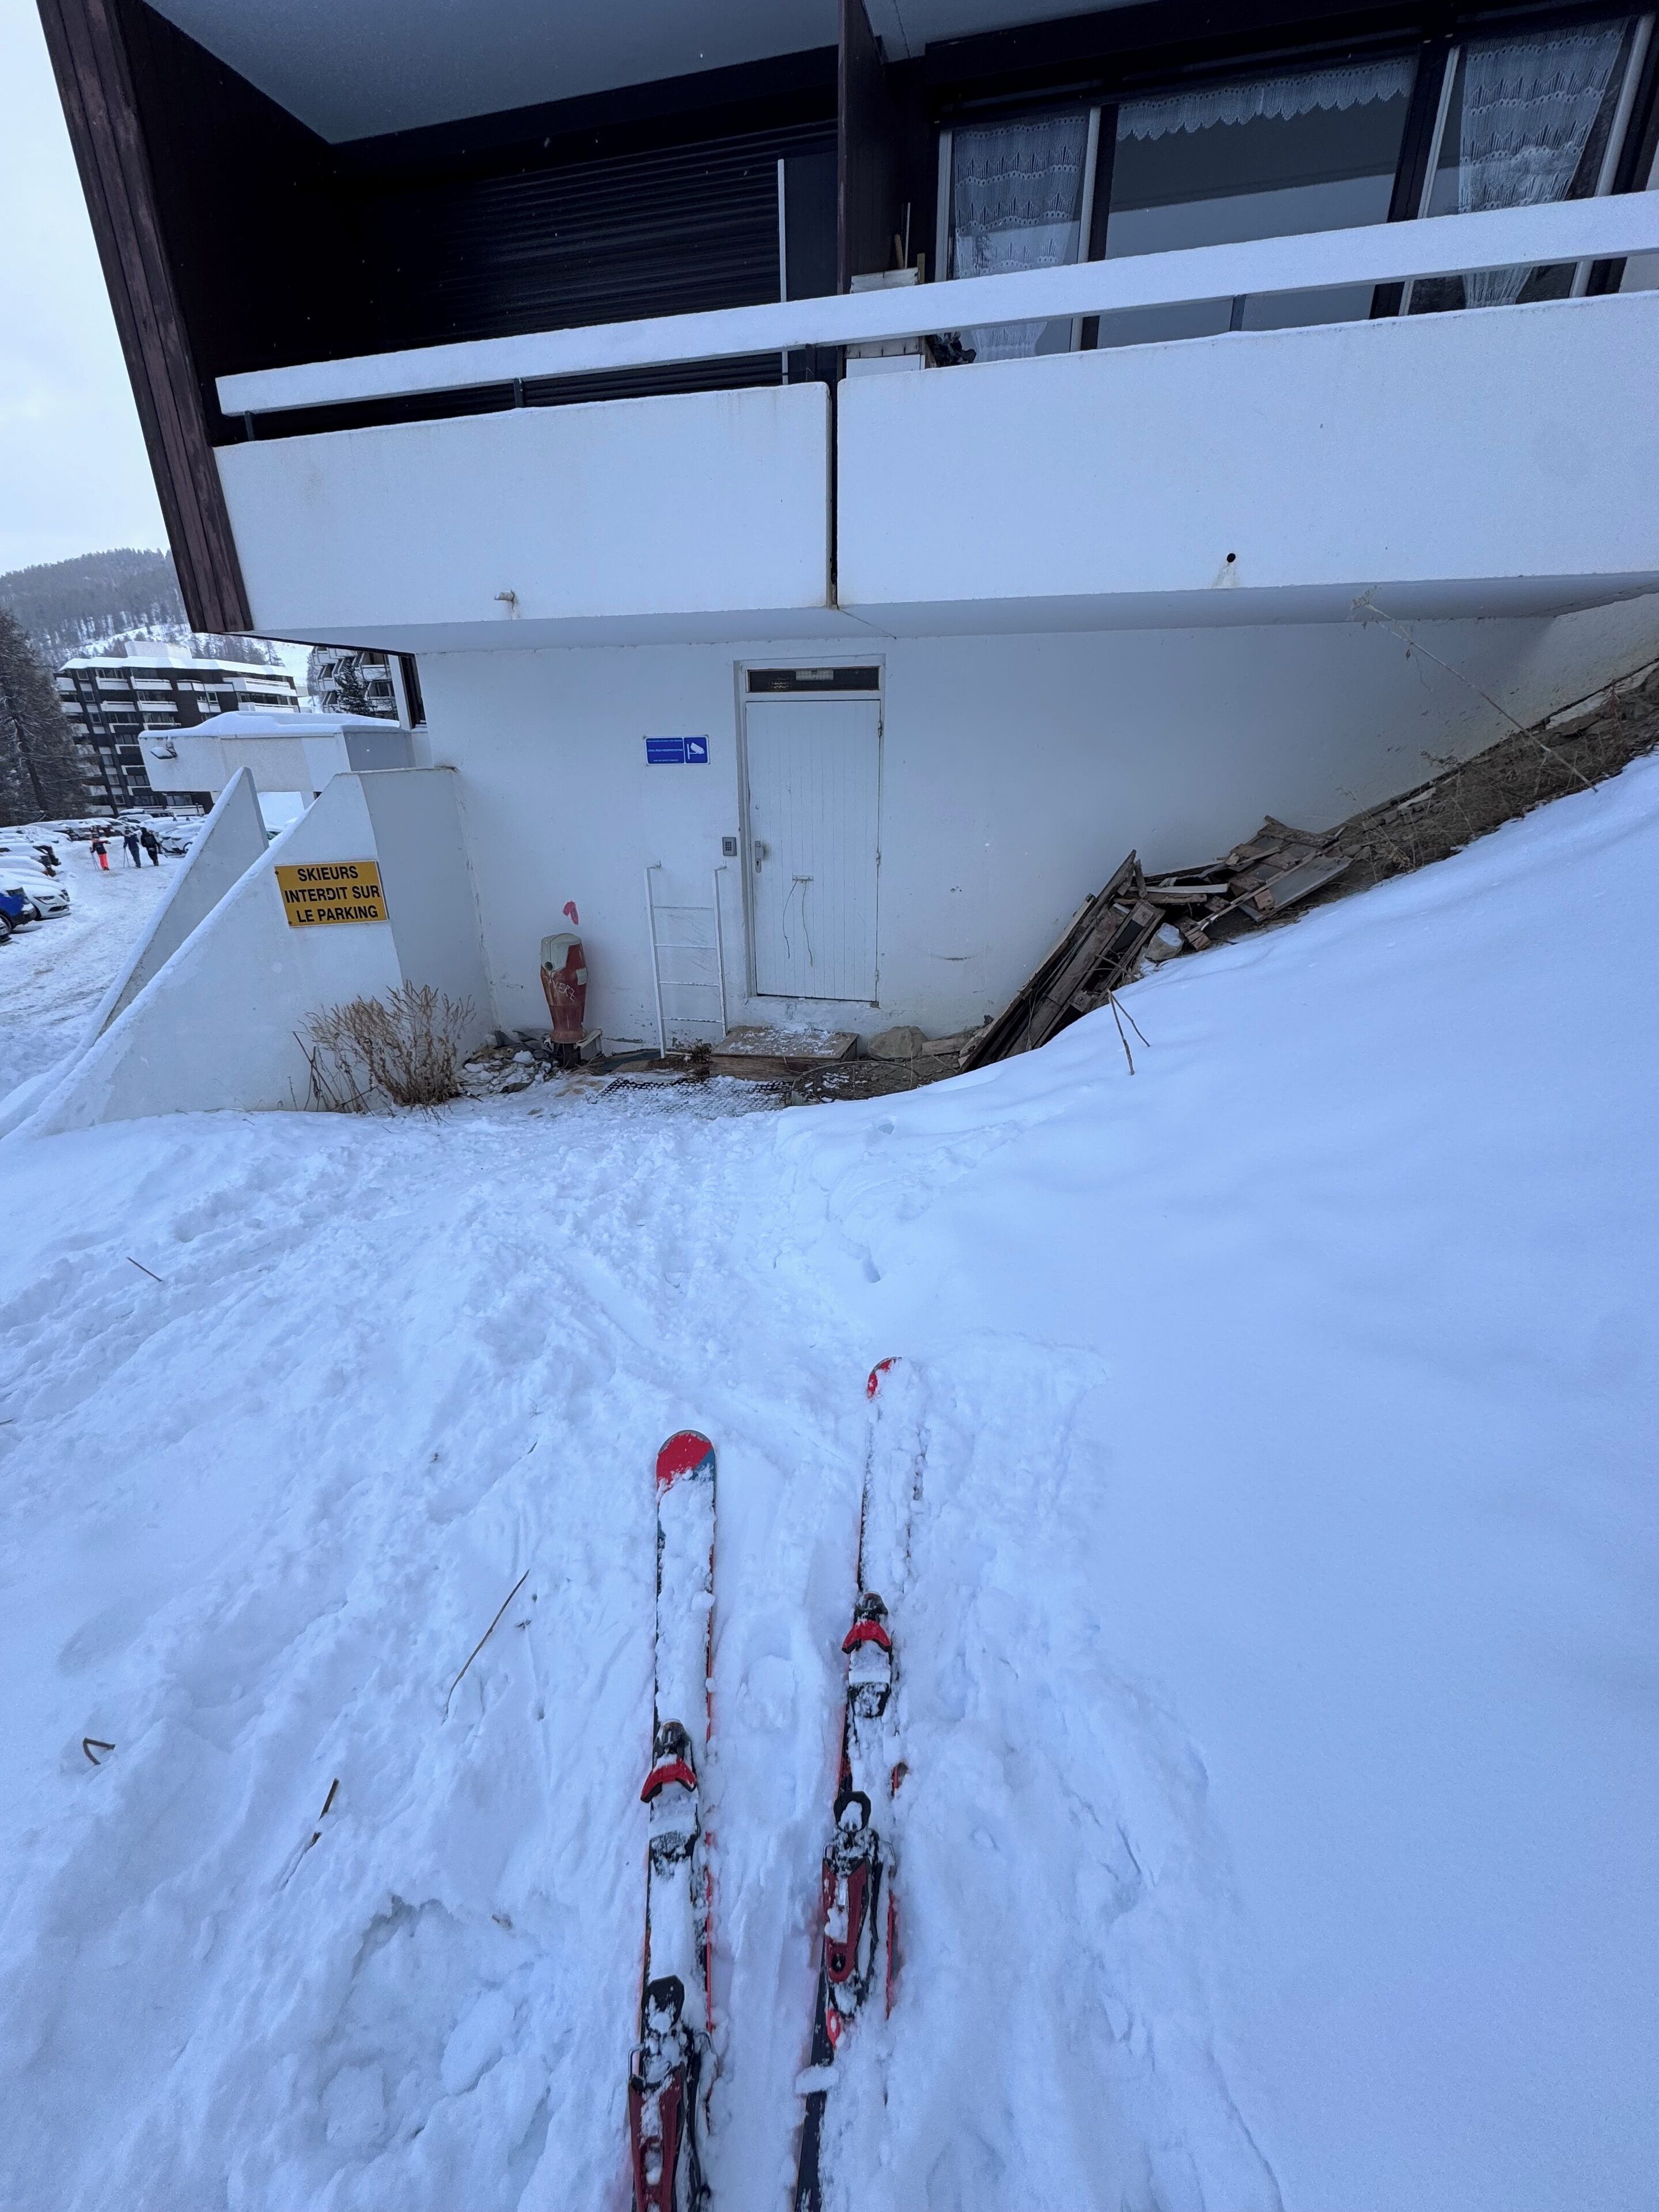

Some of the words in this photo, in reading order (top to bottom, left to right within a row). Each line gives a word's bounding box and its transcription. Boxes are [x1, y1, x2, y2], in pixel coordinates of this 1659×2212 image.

[298, 866, 358, 881] SKIEURS
[285, 887, 347, 903] INTERDIT
[352, 885, 380, 899] SUR
[297, 910, 315, 923] LE
[317, 906, 378, 921] PARKING
